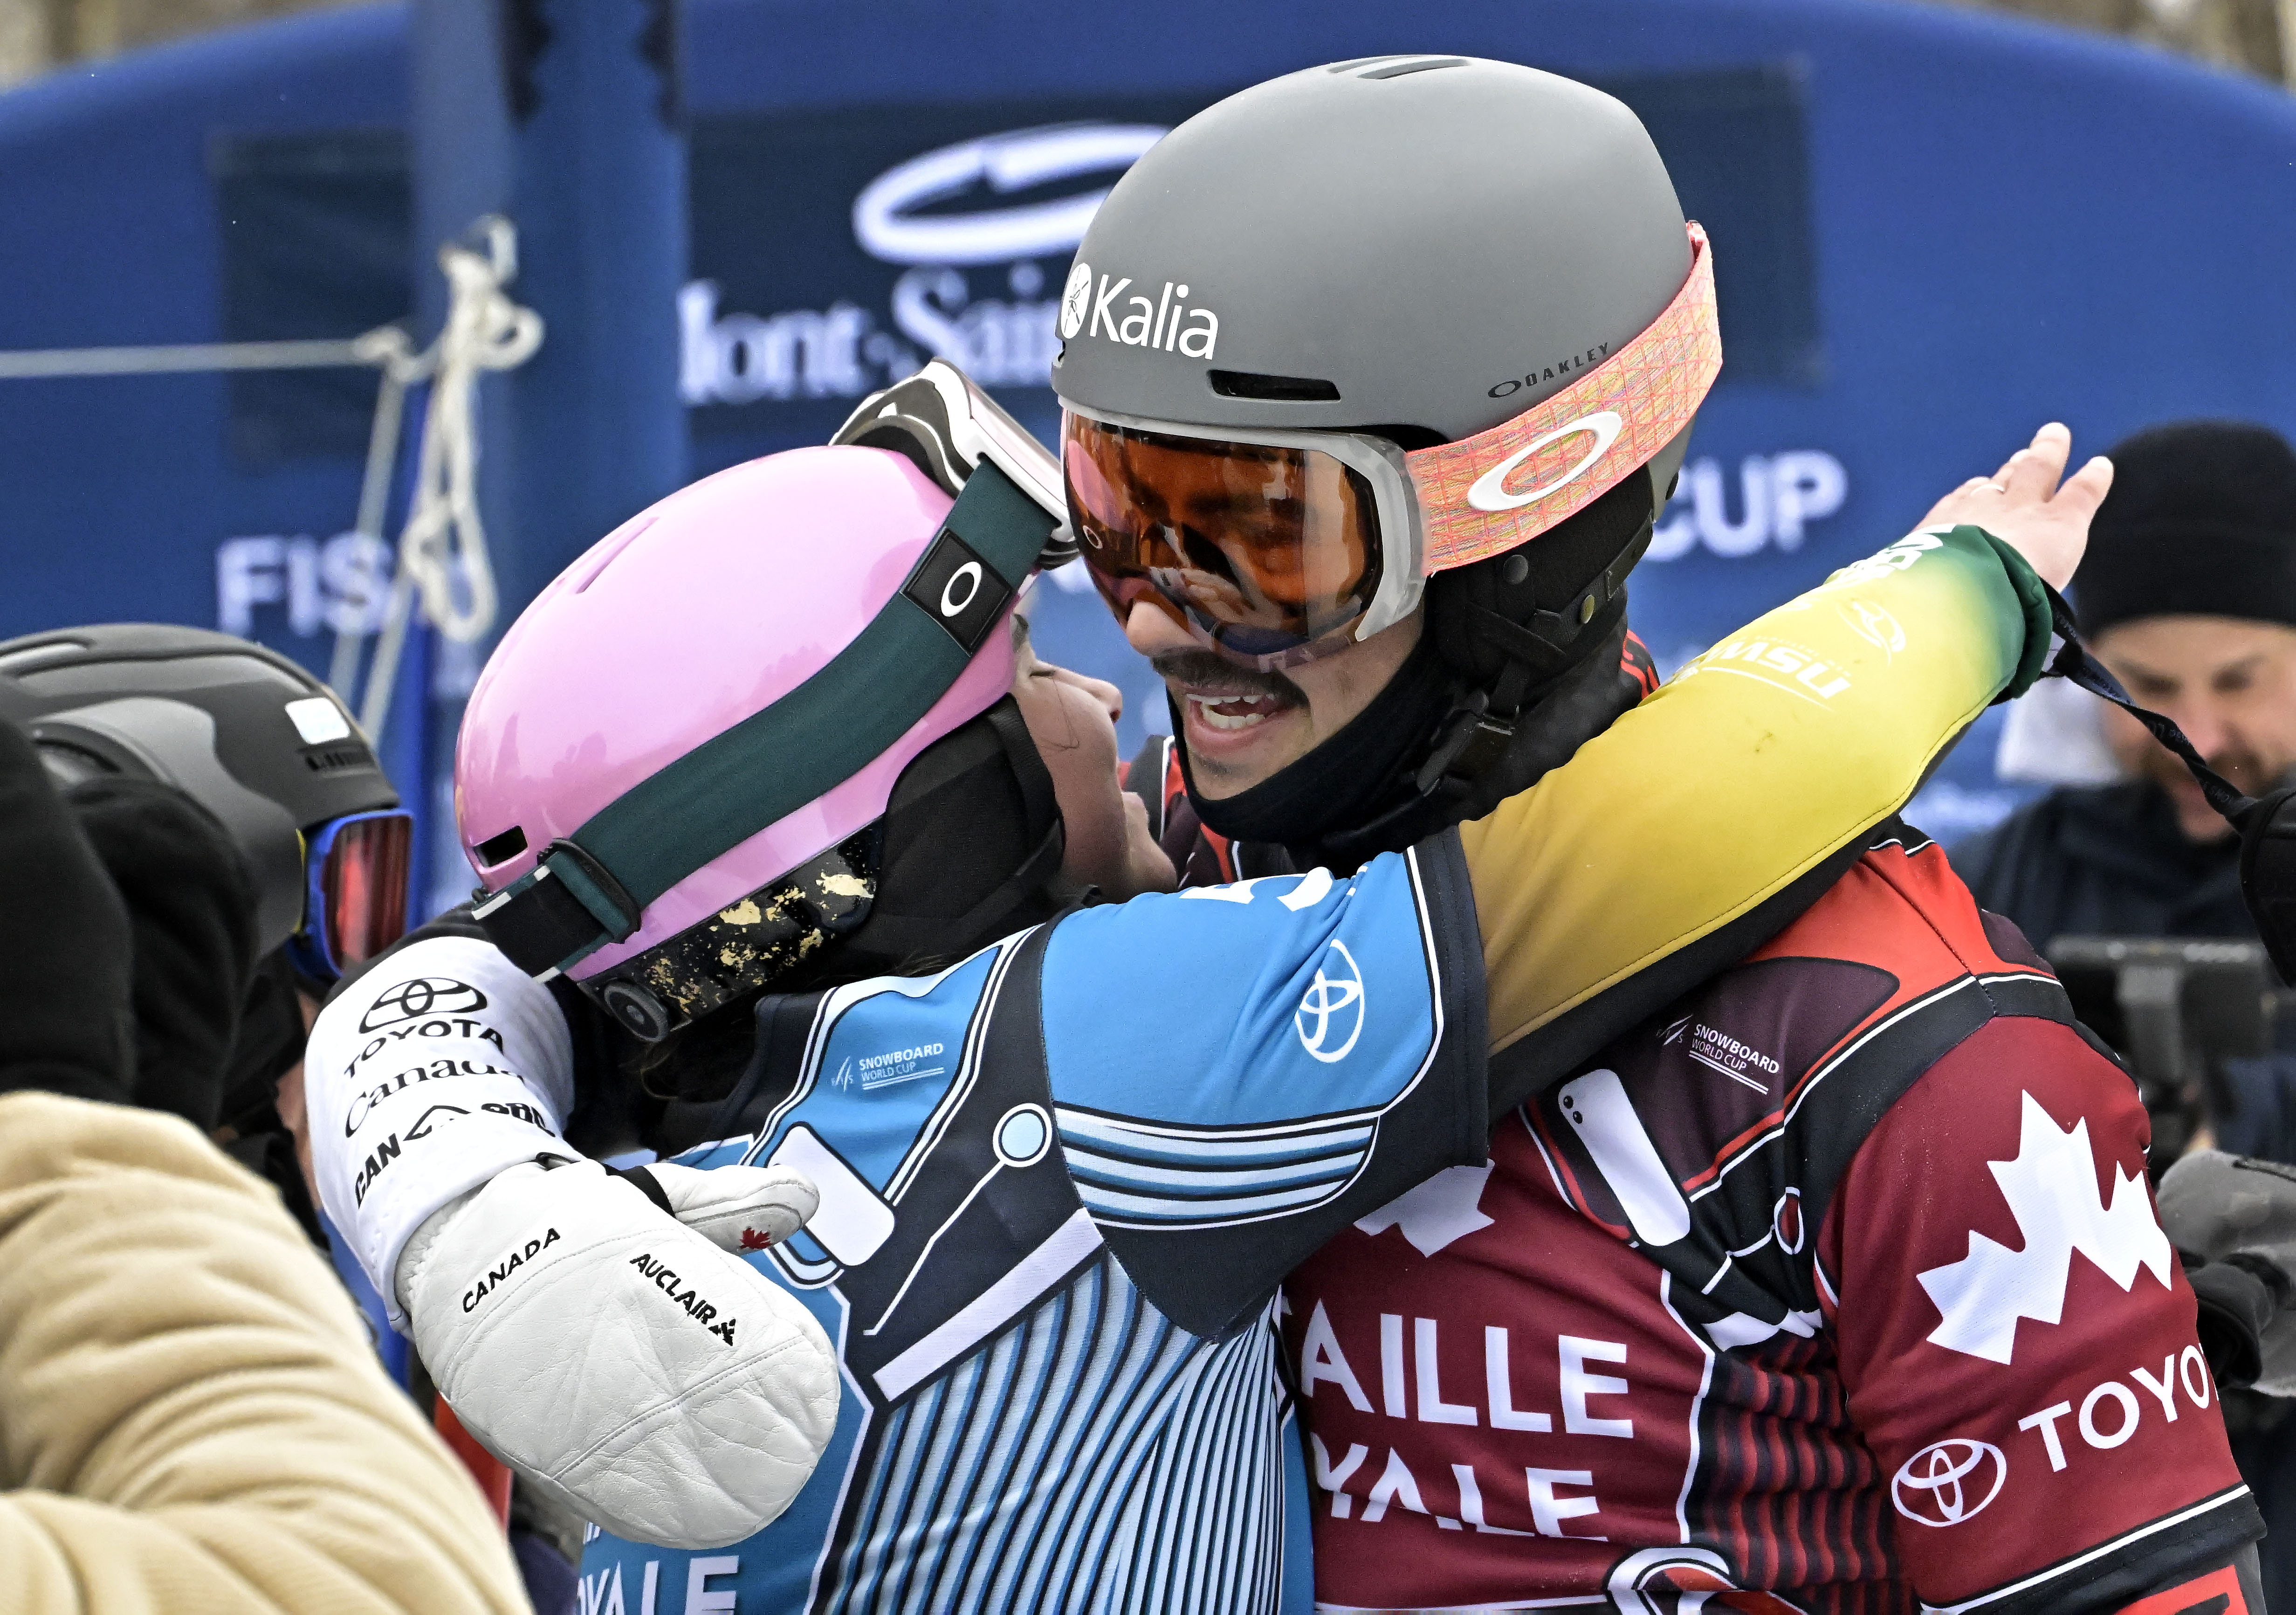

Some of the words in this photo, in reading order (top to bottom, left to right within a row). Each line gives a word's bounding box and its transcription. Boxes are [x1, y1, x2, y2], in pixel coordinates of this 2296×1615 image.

[1089, 274, 1219, 360] Kalia
[1525, 342, 1608, 386] OAKLEY
[216, 535, 396, 638] FIS
[344, 1019, 504, 1078] TOYOTA
[859, 1043, 943, 1071] SNOWBOARD
[861, 1068, 894, 1082] WORLD
[896, 1063, 916, 1074] CUP
[1692, 1038, 1724, 1060] WORLD
[1724, 1055, 1747, 1071] CUP
[1694, 1024, 1779, 1073] SNOWBOARD
[354, 1133, 401, 1209] CAN
[463, 1228, 560, 1313] CANADA
[629, 1253, 717, 1326] AUCLAIR
[1281, 1296, 1633, 1438] AILLE
[2018, 1342, 2219, 1473] TOYO
